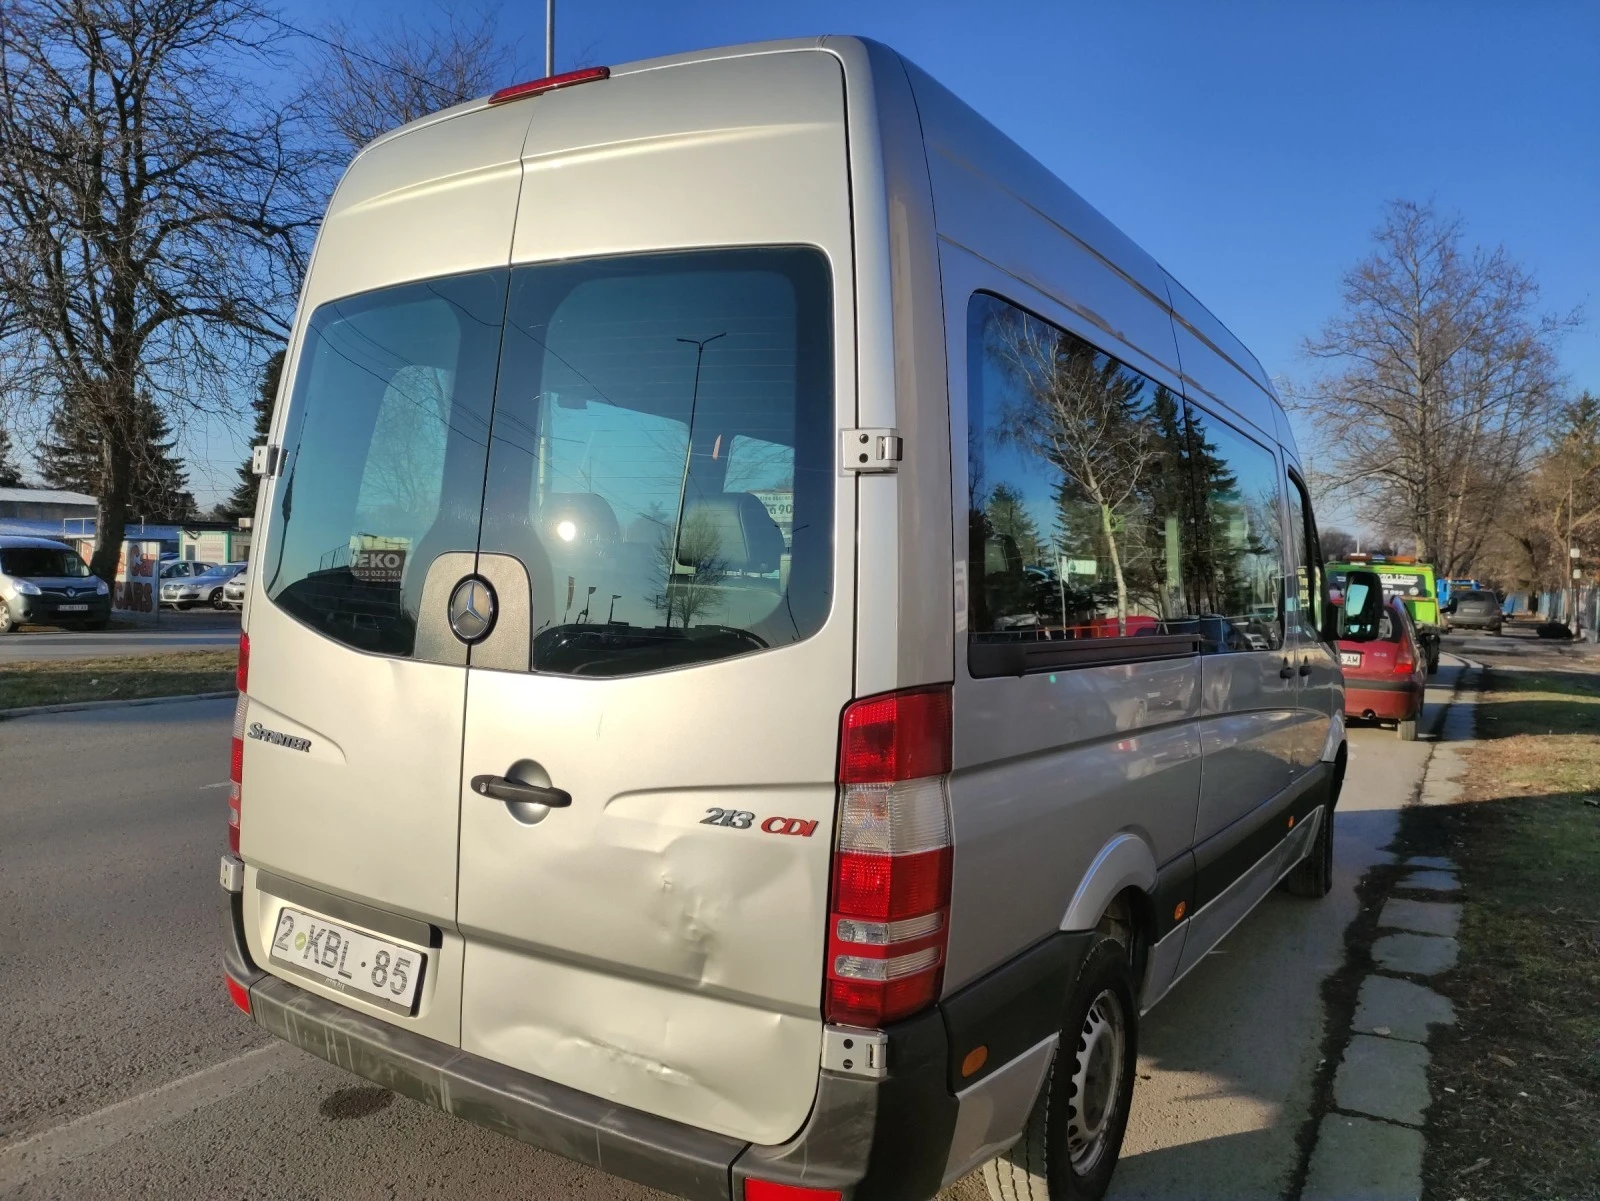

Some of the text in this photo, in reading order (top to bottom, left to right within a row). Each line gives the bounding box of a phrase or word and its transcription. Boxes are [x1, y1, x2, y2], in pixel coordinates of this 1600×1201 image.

[114, 581, 152, 613] CARS
[699, 807, 820, 838] 213 CDI
